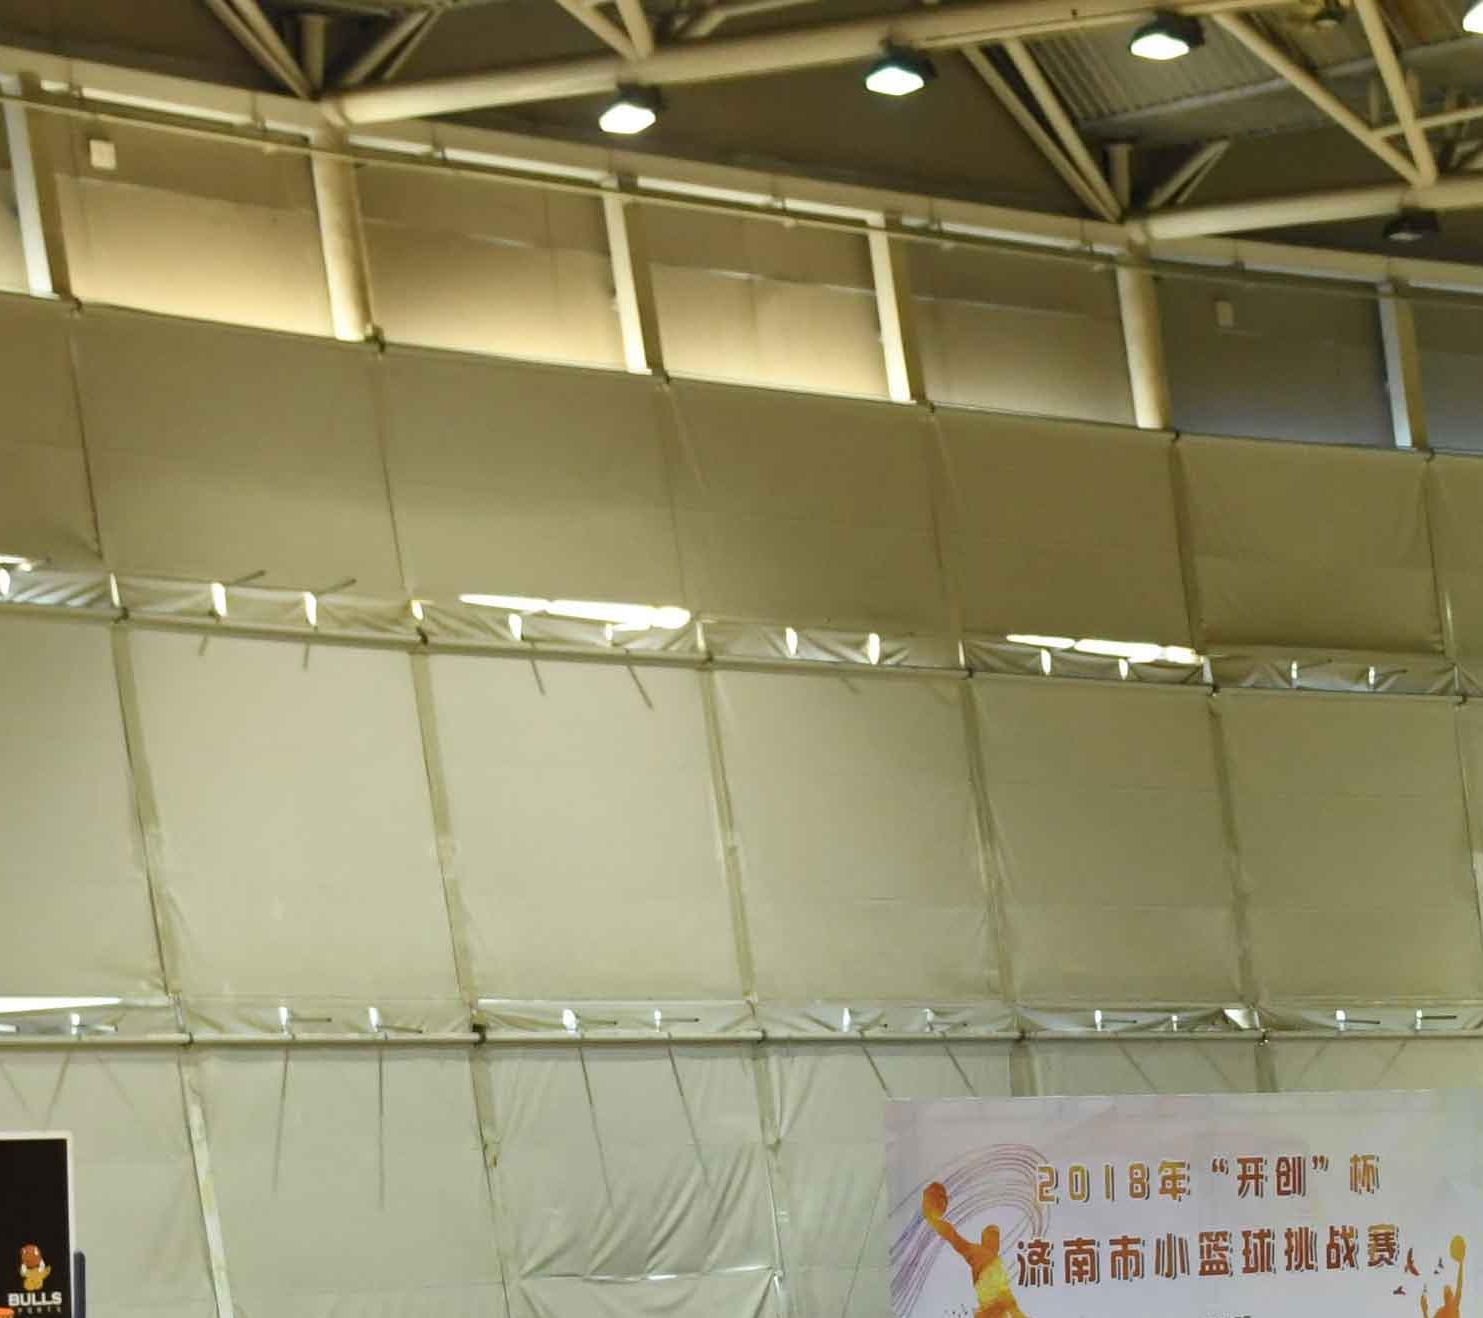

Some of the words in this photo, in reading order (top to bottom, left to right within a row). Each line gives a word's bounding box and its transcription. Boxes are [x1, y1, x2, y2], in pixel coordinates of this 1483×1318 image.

[1018, 1224, 1400, 1287] 济南市小篮球挑战赛
[8, 1292, 62, 1307] BULLS
